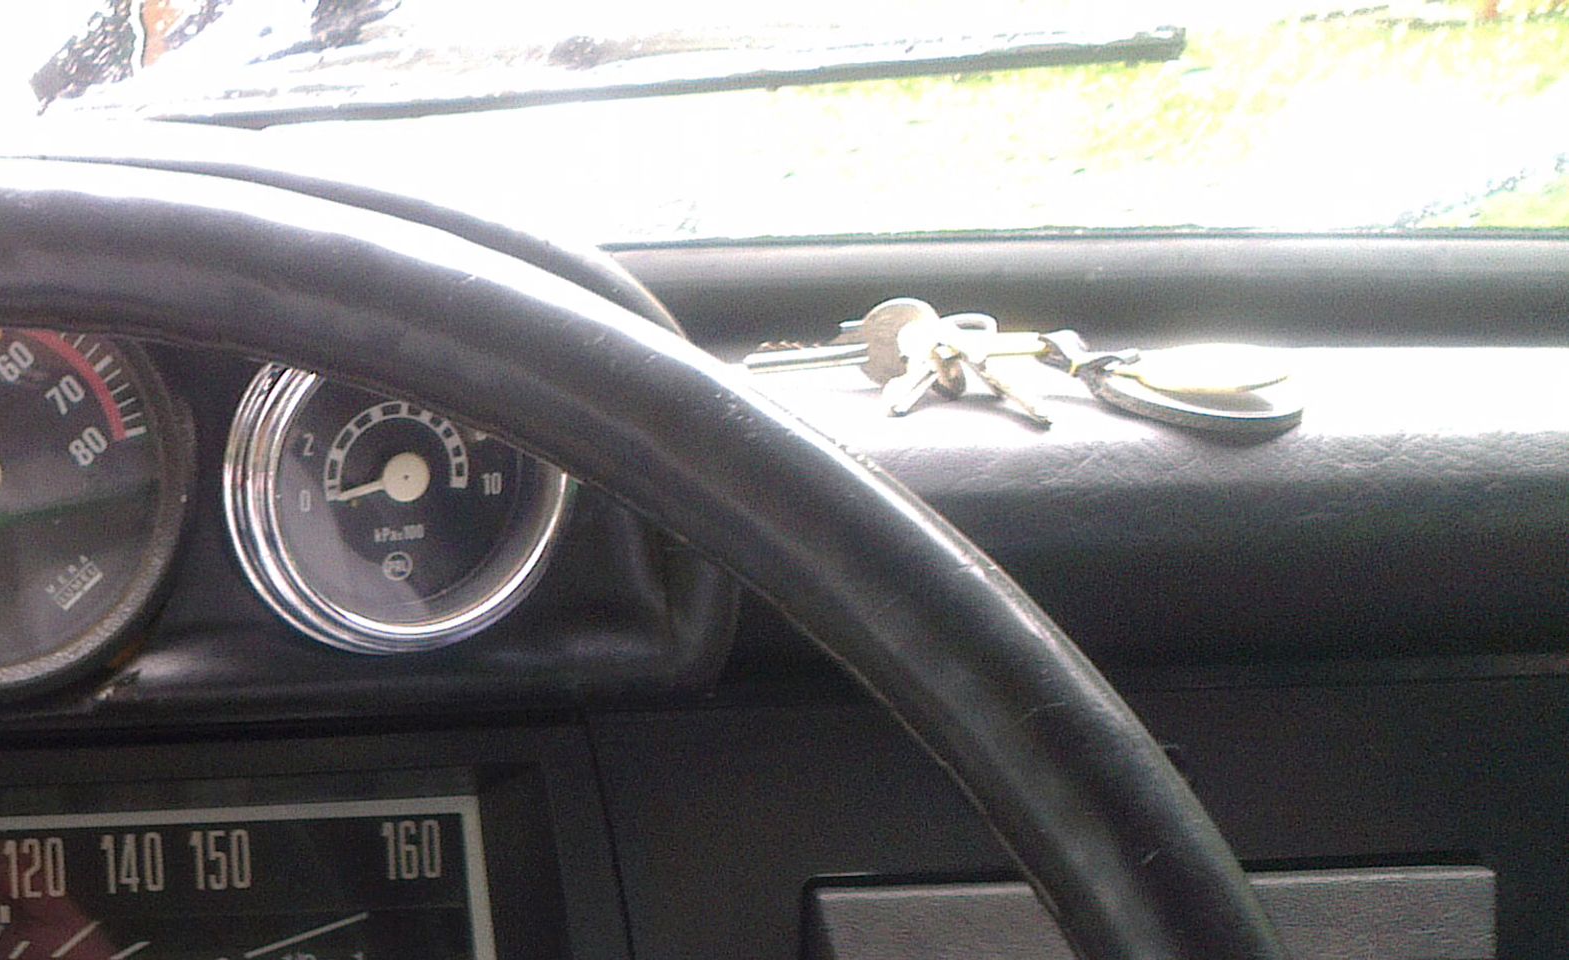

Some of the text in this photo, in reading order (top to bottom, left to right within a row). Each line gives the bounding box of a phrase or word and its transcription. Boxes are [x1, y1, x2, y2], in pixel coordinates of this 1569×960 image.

[45, 375, 85, 415] 70
[68, 426, 108, 467] 80
[482, 473, 502, 495] 10
[4, 837, 65, 899] 120
[101, 832, 164, 894] 140
[189, 829, 251, 891] 150
[381, 820, 441, 880] 160
